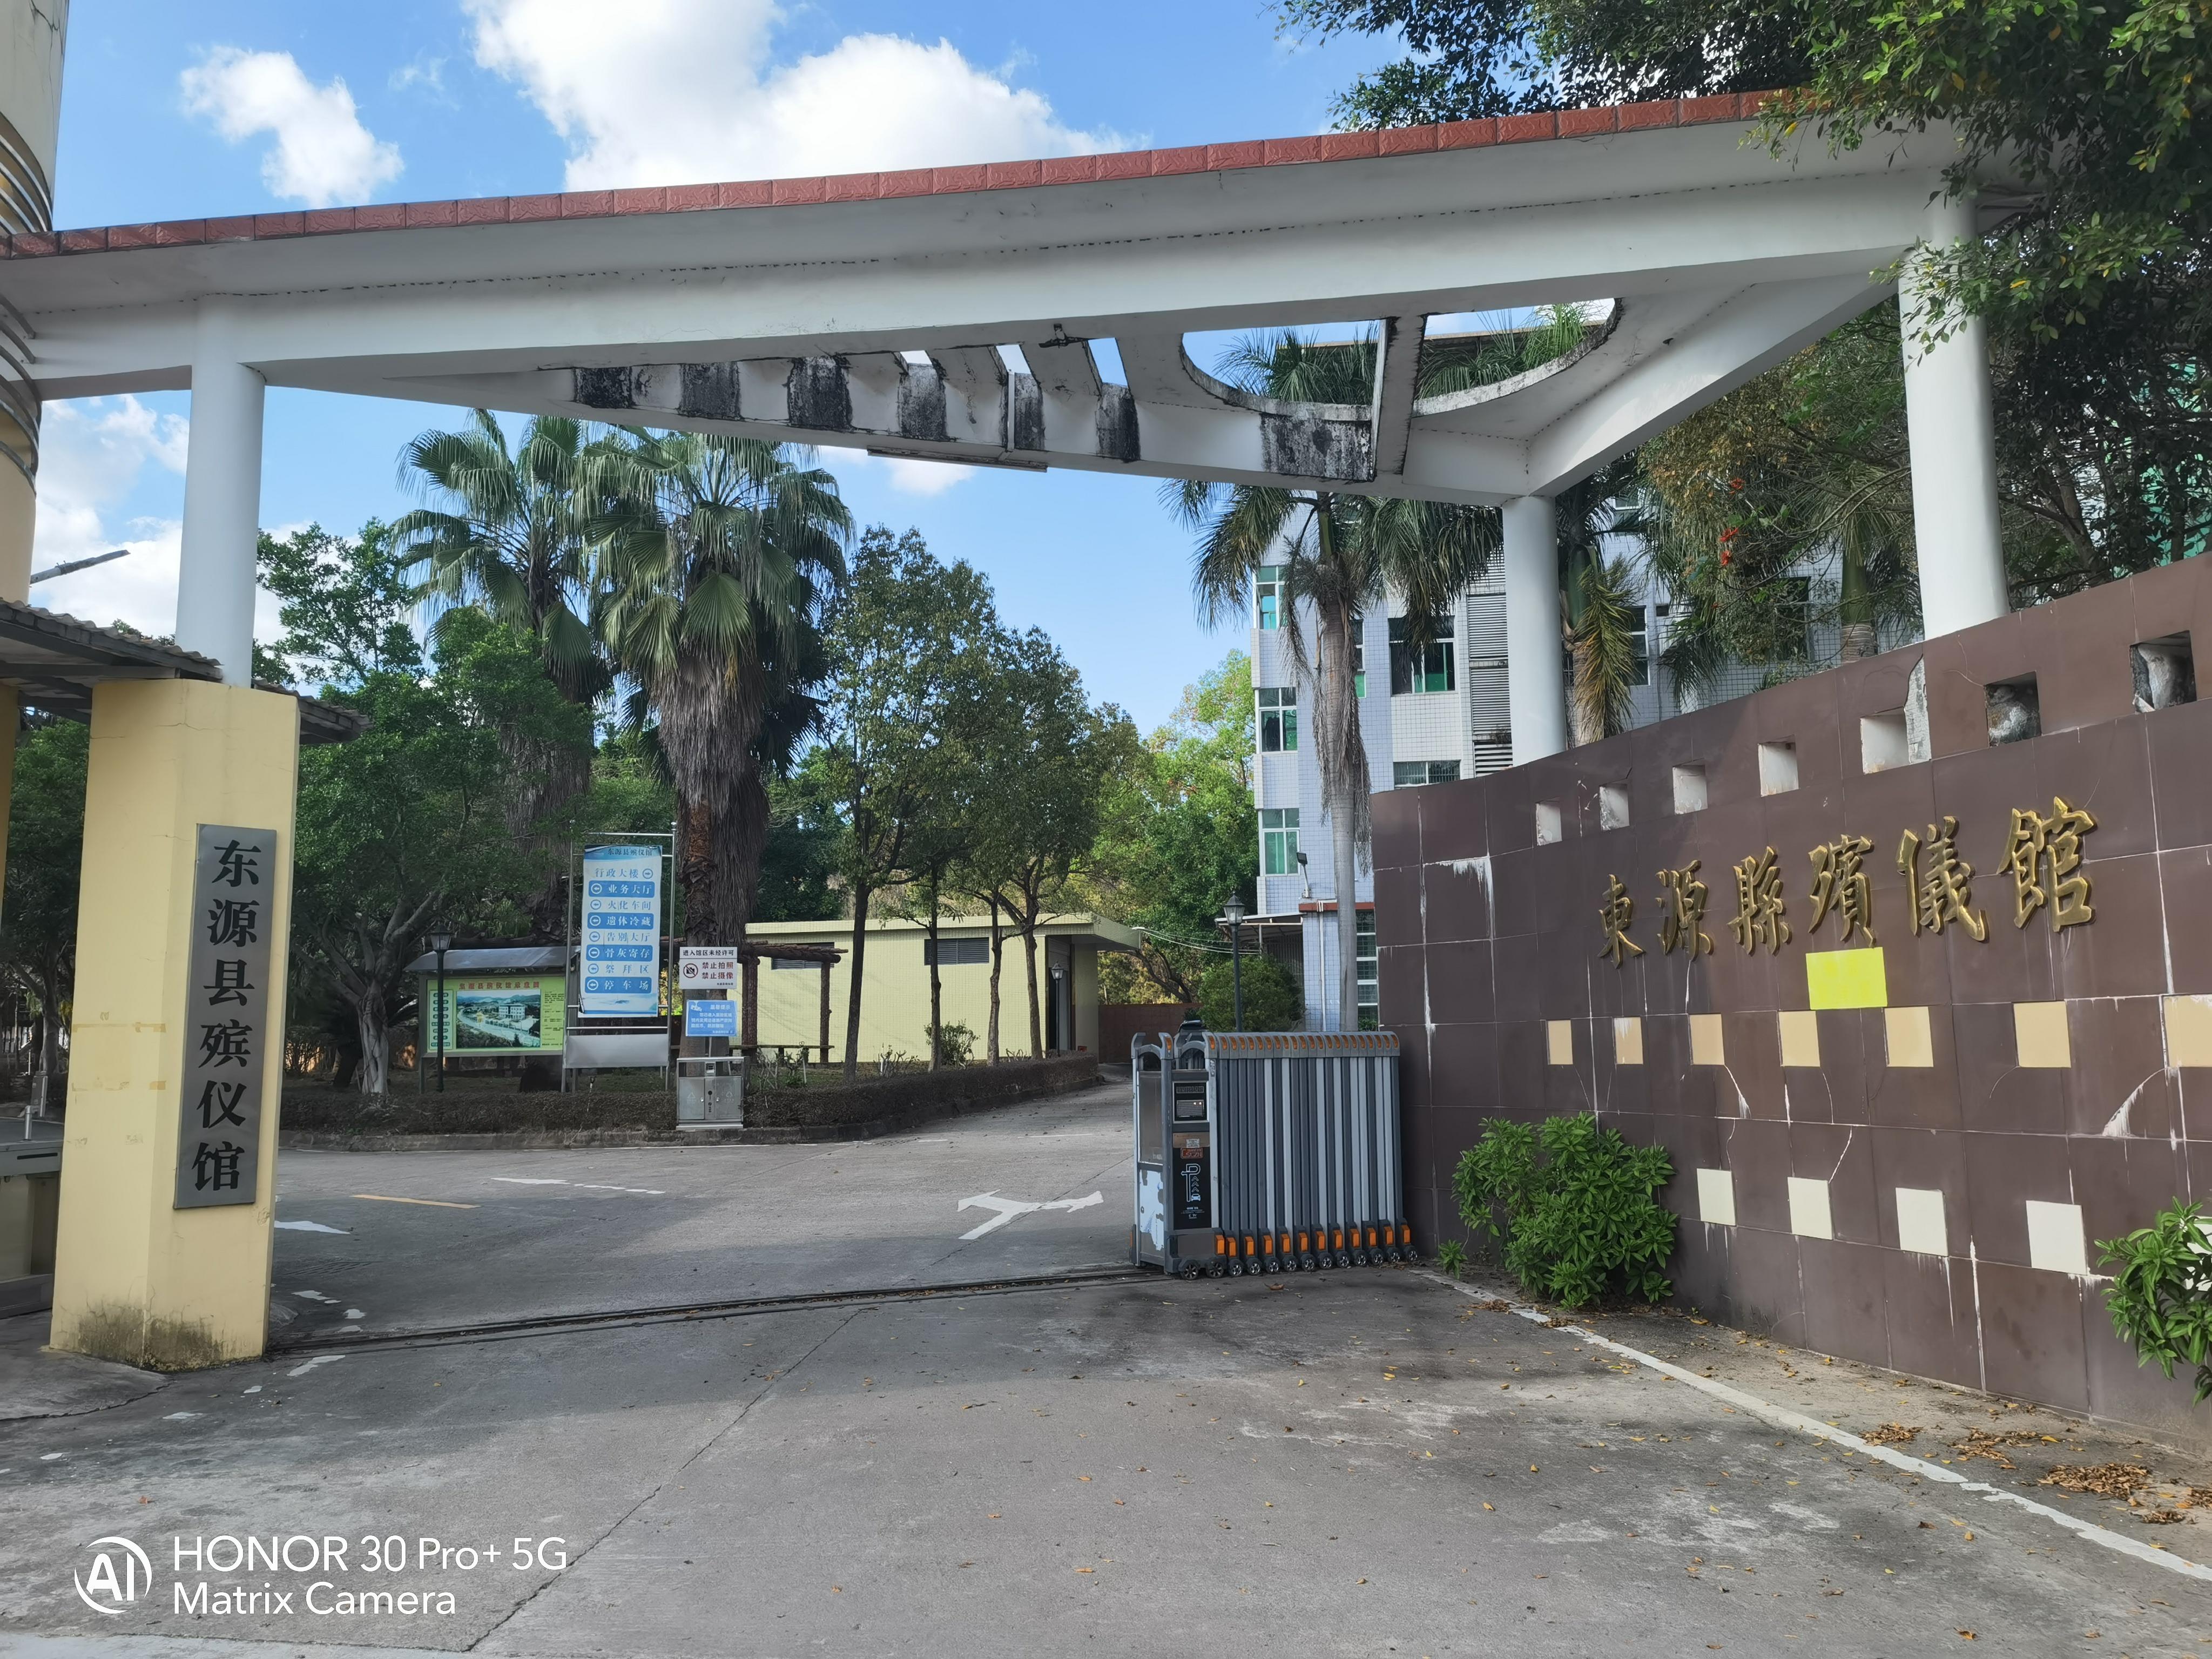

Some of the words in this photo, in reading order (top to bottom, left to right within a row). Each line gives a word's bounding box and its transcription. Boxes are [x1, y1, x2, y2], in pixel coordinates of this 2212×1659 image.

[608, 848, 652, 856] 东源县殡仪馆
[595, 868, 638, 878] 行政大楼
[1598, 795, 2097, 969] 東源縣殯儀館
[608, 884, 652, 894] 业务大厅
[608, 900, 651, 910] 火化车间
[606, 916, 651, 926] 遗体冷藏
[607, 932, 650, 942] 告别大厅
[605, 948, 650, 958] 骨灰寄存
[605, 964, 649, 974] 祭拜区
[604, 980, 649, 990] 停车场
[191, 840, 262, 1191] 东源县殡仪馆
